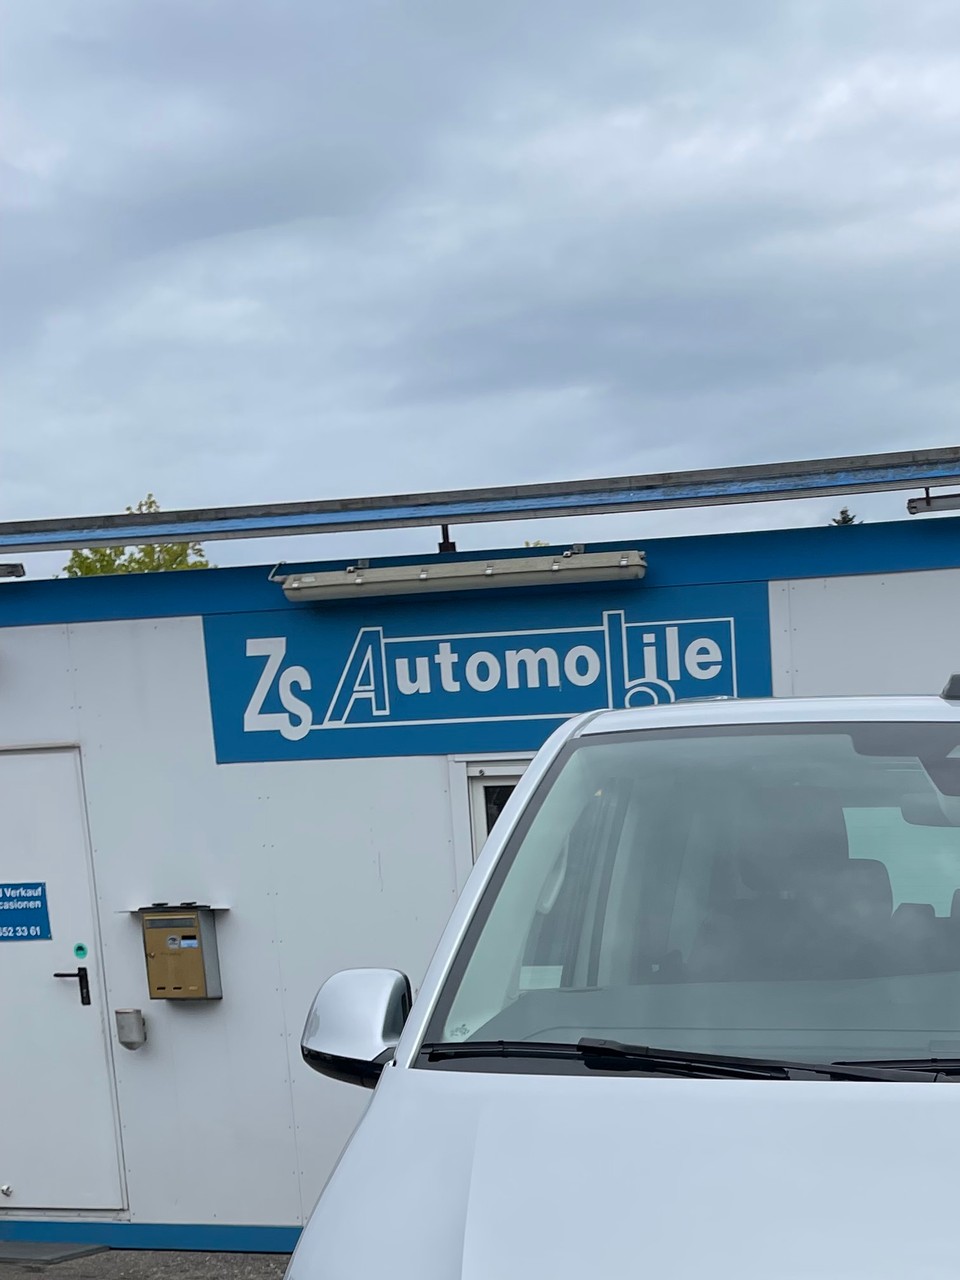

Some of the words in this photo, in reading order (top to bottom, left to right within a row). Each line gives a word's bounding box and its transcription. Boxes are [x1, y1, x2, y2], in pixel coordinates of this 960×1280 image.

[323, 610, 724, 725] Automobile
[4, 886, 42, 898] Verkauf
[16, 926, 28, 936] 33
[30, 925, 41, 936] 61
